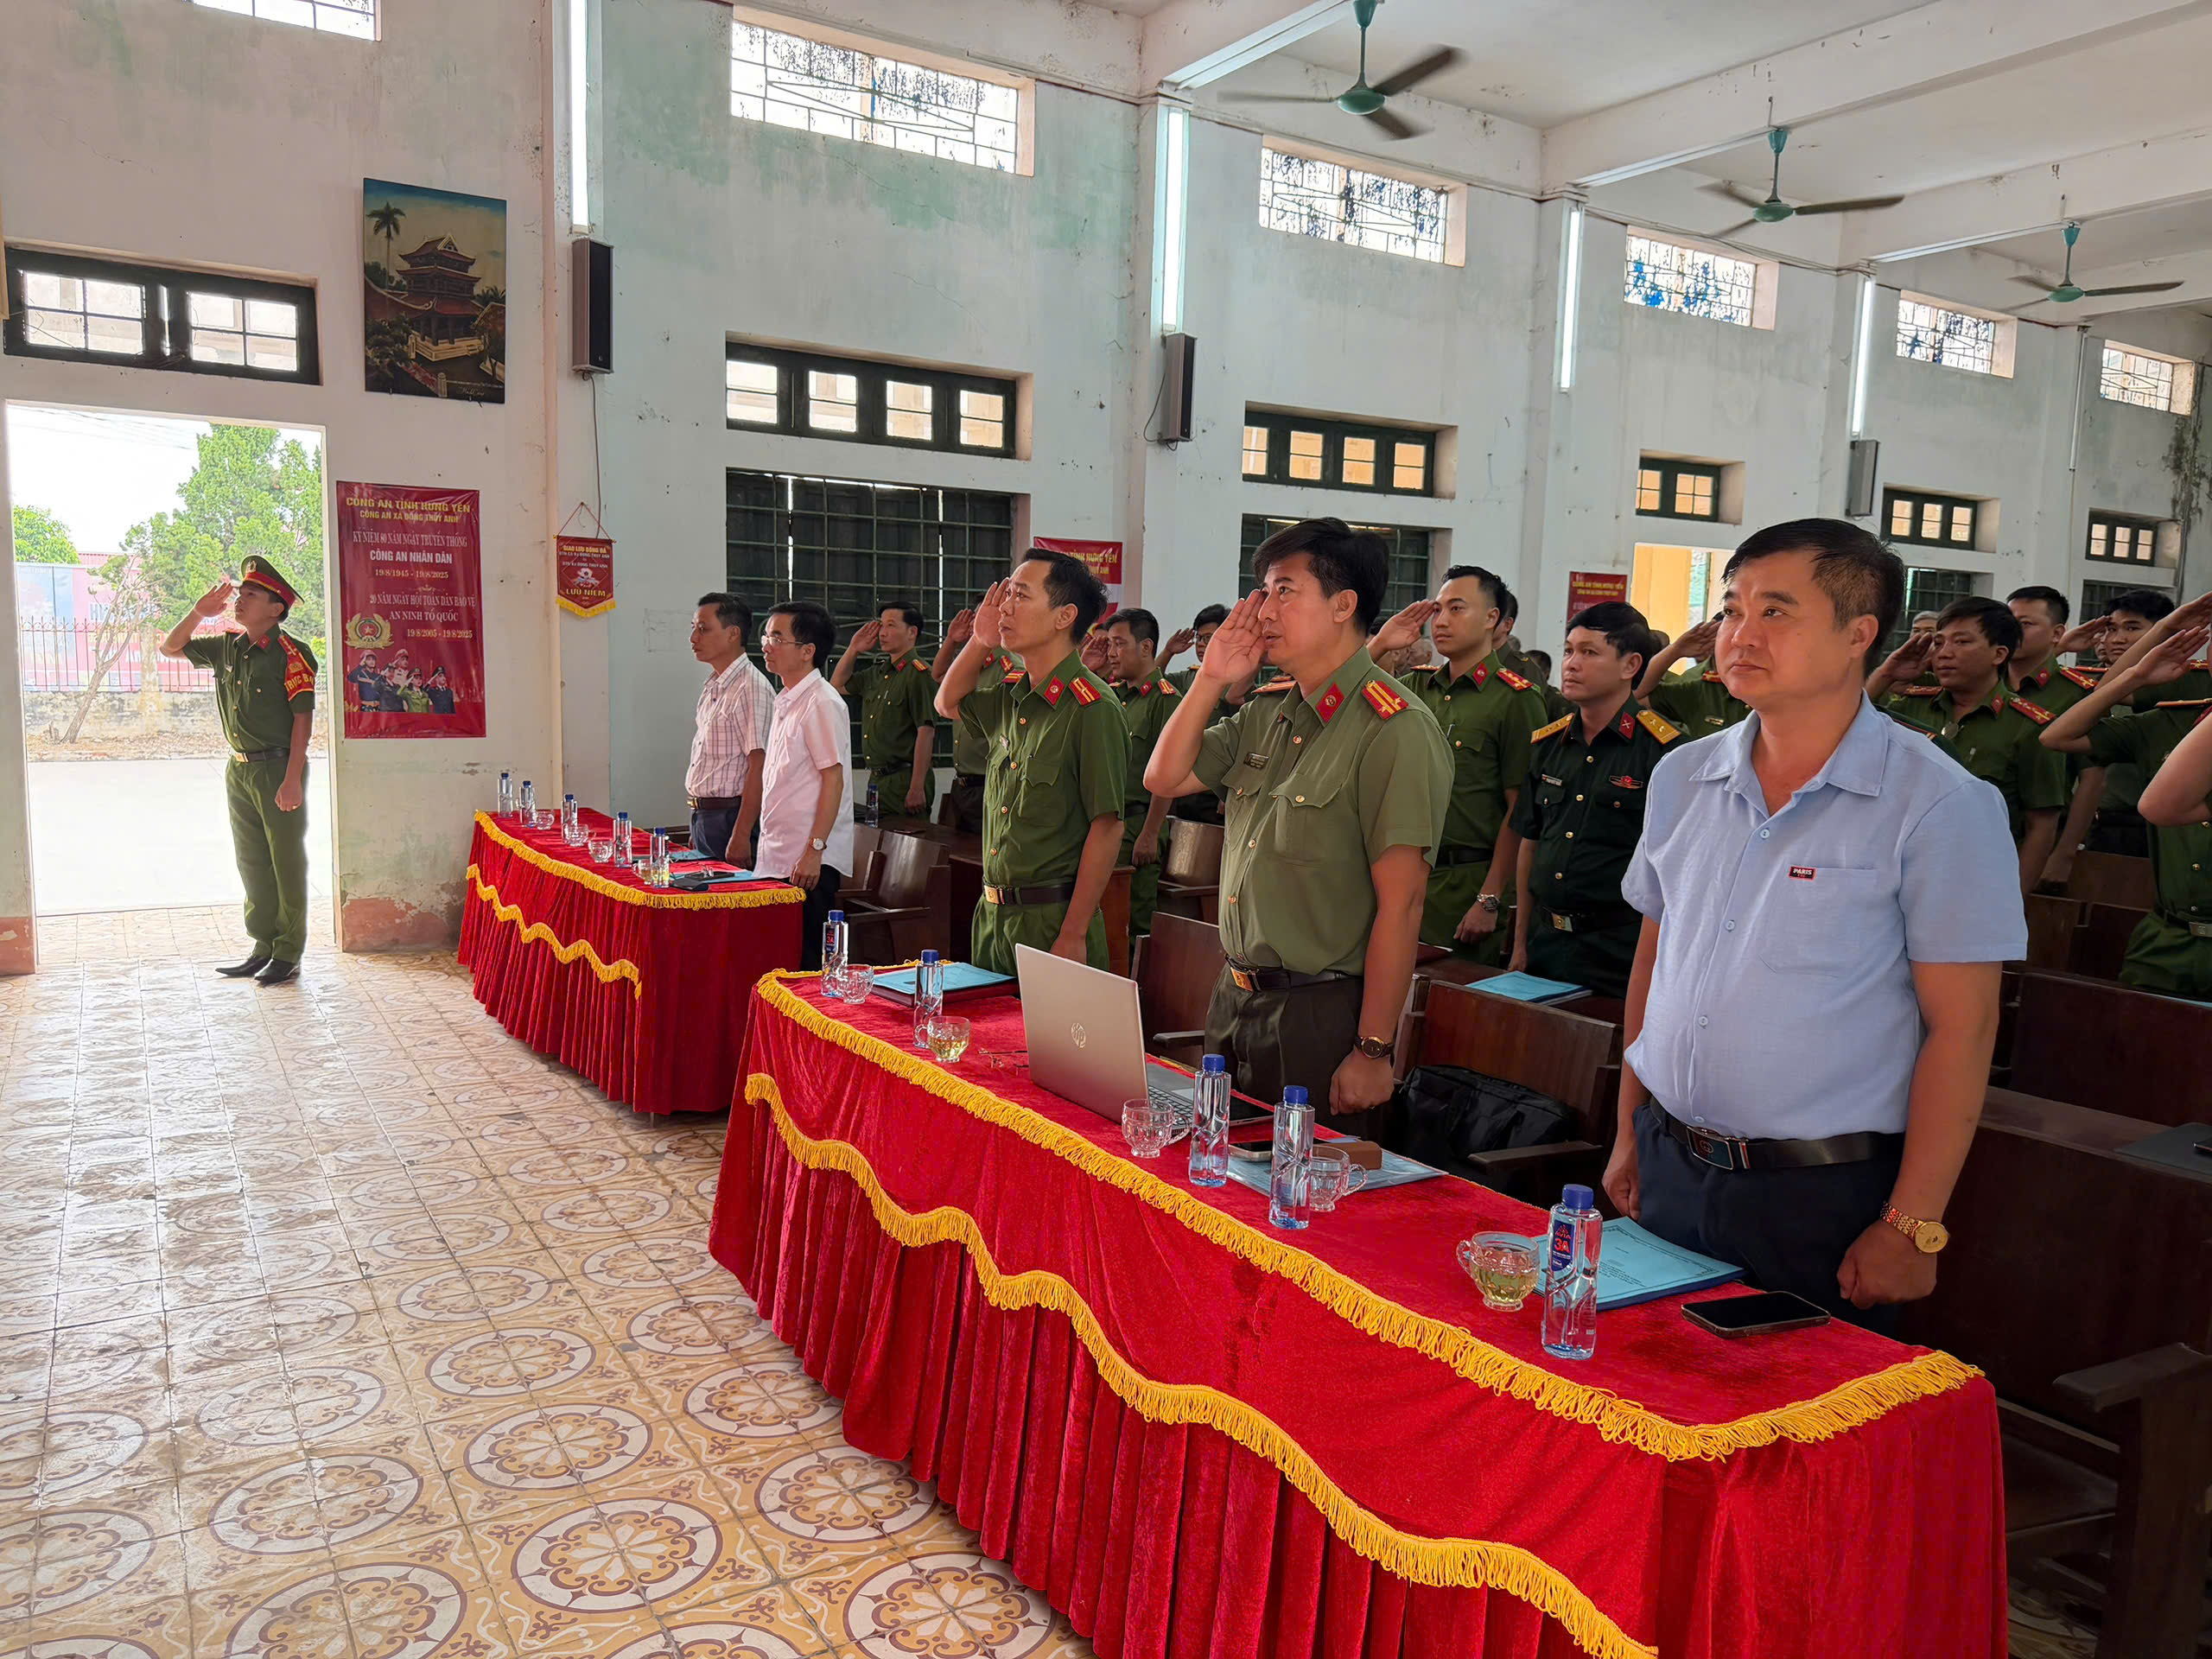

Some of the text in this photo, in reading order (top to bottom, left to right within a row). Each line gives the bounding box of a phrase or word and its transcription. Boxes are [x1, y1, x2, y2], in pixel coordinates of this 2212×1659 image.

[346, 496, 374, 507] CÔNG
[378, 499, 392, 509] AN
[359, 507, 379, 518] CÔNG
[381, 512, 391, 520] AN
[380, 534, 387, 543] 80
[370, 548, 453, 564] CÔNG AN NHÂN DÂN
[375, 569, 409, 577] 19/8/1945
[416, 569, 448, 579] 19/8/2025
[389, 607, 459, 623] AN NINH TỔ QUỐC
[1554, 1237, 1571, 1253] 3A
